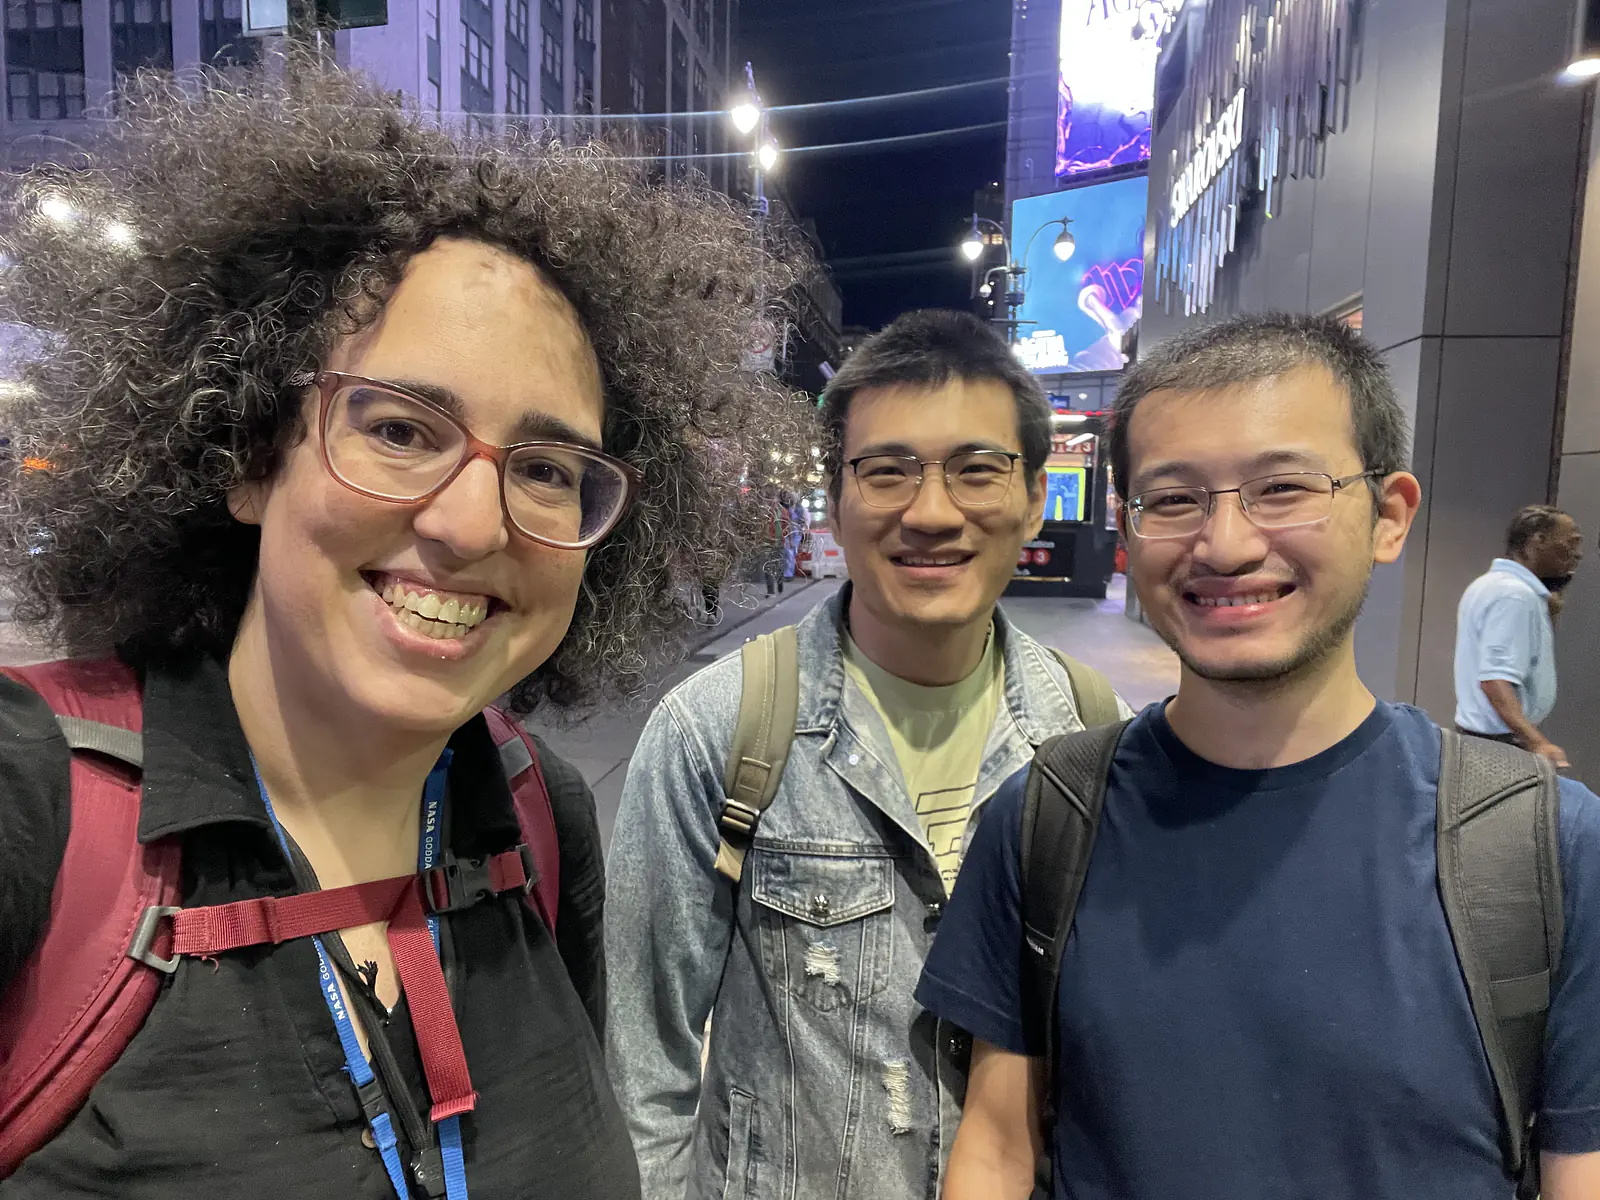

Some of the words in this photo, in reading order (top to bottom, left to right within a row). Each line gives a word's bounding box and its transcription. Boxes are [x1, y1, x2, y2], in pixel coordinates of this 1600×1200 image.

[1171, 87, 1245, 228] SWAROVSKI
[427, 801, 437, 833] NASA
[425, 836, 433, 870] GODDA
[328, 982, 345, 1021] NASA
